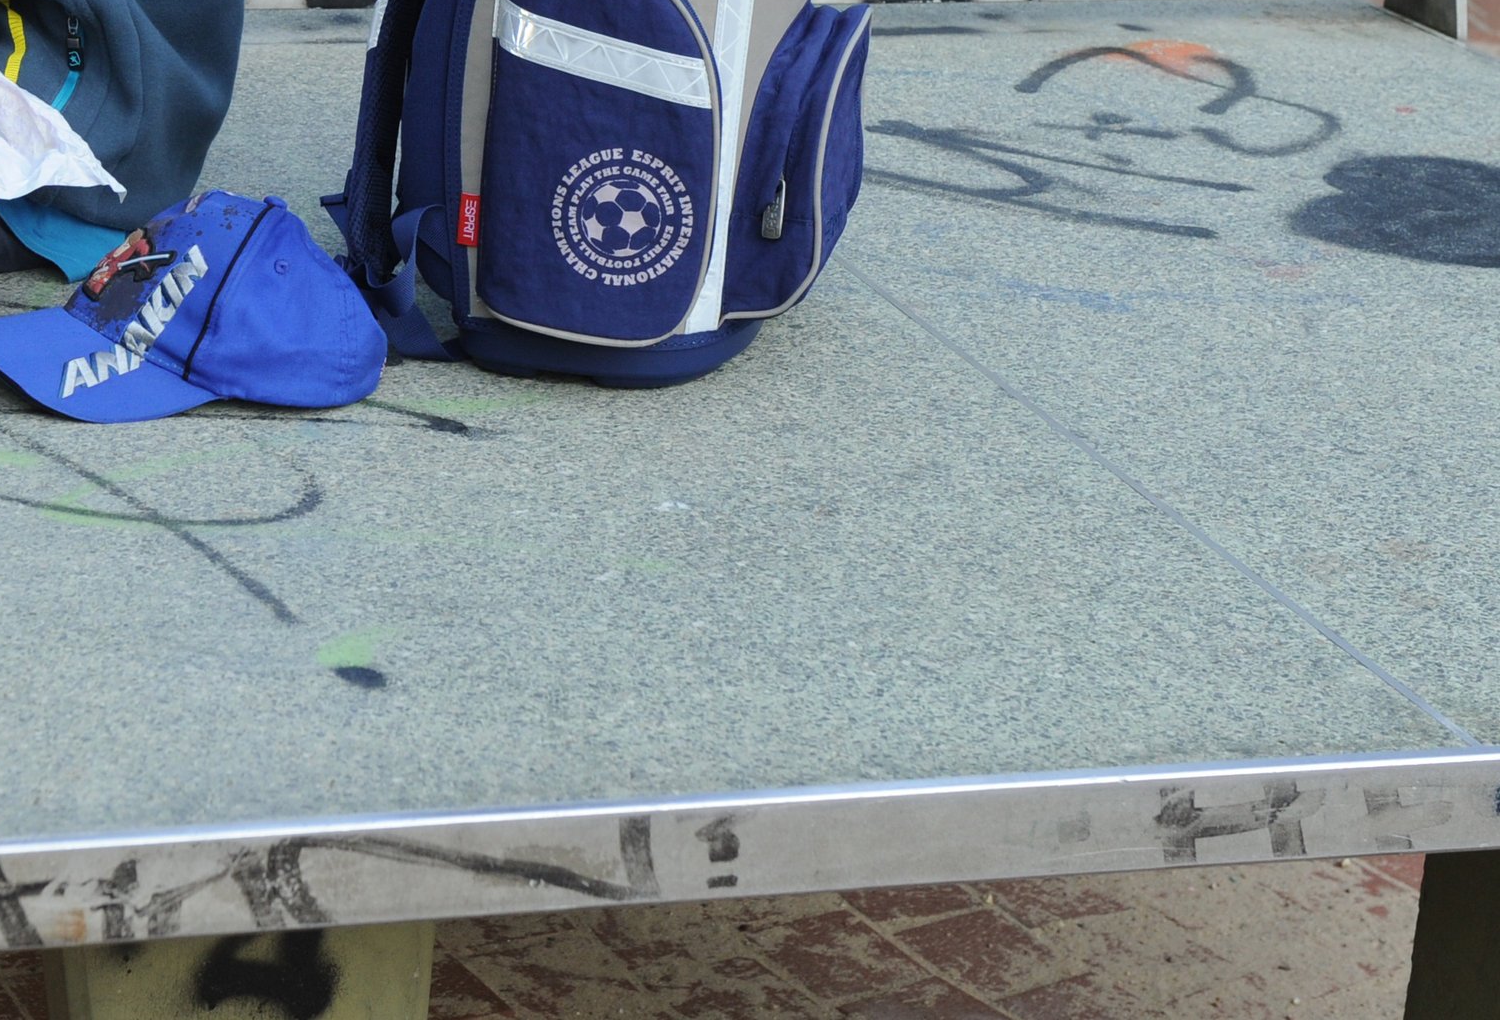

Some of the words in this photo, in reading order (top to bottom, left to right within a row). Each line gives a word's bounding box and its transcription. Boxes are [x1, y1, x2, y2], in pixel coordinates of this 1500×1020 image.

[562, 148, 624, 186] LEAGUE
[594, 166, 621, 180] THE
[623, 166, 660, 188] GAME
[632, 149, 686, 193] ESPRIT
[571, 176, 593, 205] PLAY
[656, 185, 675, 216] FAIR
[463, 199, 477, 242] ESPRIT
[551, 185, 598, 280] CHAMPIONS
[568, 205, 584, 244] TEAM
[579, 242, 642, 268] FOOTBALL
[601, 194, 694, 286] INTERNATIONAL
[643, 225, 674, 263] ESPRIT
[59, 244, 209, 400] ANAKIN
